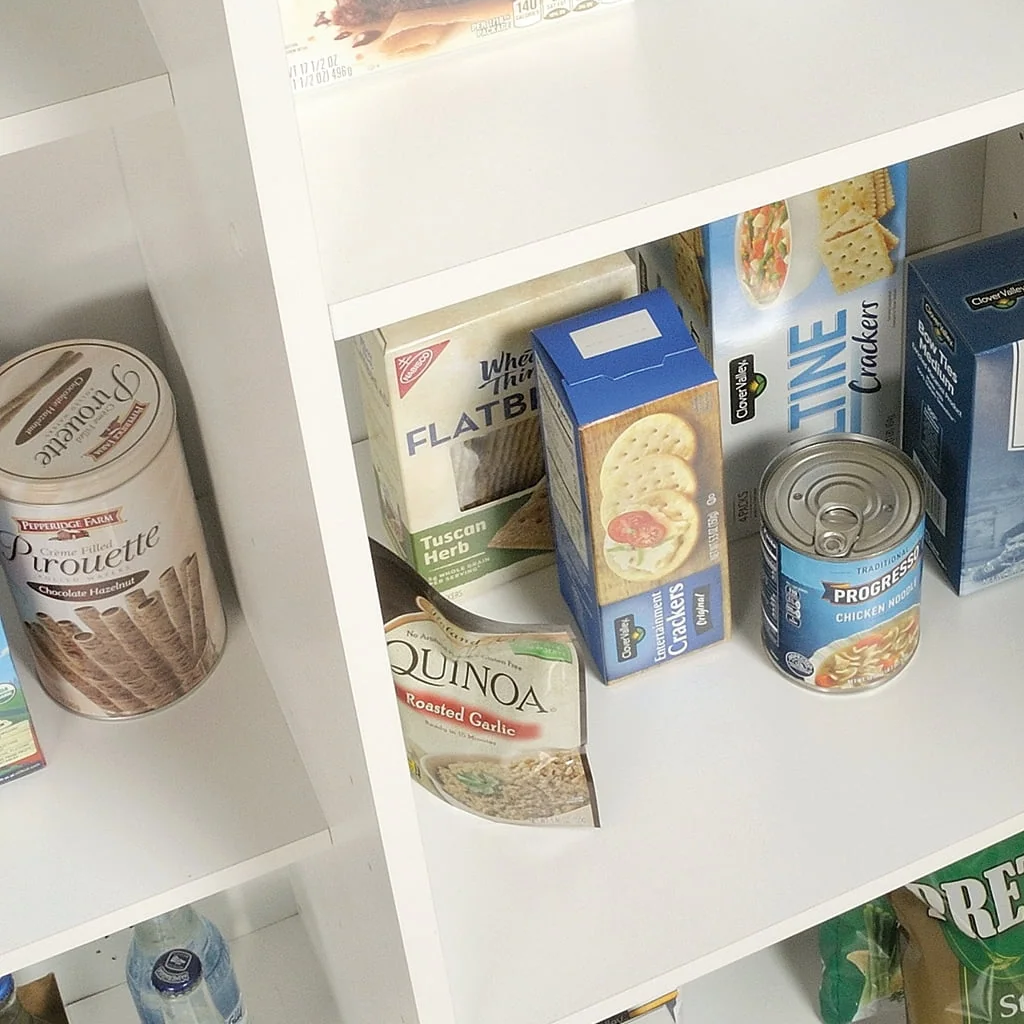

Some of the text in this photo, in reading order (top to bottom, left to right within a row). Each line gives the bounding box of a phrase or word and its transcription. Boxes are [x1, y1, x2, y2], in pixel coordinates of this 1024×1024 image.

[327, 54, 338, 68] OZ
[849, 300, 882, 395] Crackers
[919, 320, 938, 354] Bow
[939, 348, 958, 384] Ties
[403, 350, 431, 382] NABISCO
[920, 337, 955, 396] Medium
[53, 376, 84, 408] Chocolate
[23, 514, 115, 531] PEPPERIDGE FARM
[420, 520, 487, 550] Tuscan
[0, 524, 160, 575] Pirouette
[81, 540, 114, 555] Filled
[424, 541, 470, 566] Herb
[856, 547, 910, 575] TRADITIONAL
[38, 576, 136, 598] Chocolate Hazelnut
[834, 545, 920, 604] PROGRESSO
[667, 582, 689, 657] Crackers
[695, 592, 709, 628] Original
[836, 602, 885, 623] CHICKEN
[653, 591, 667, 664] Entertainment
[386, 640, 550, 714] QUINOA
[406, 692, 517, 737] Roasted Garlic
